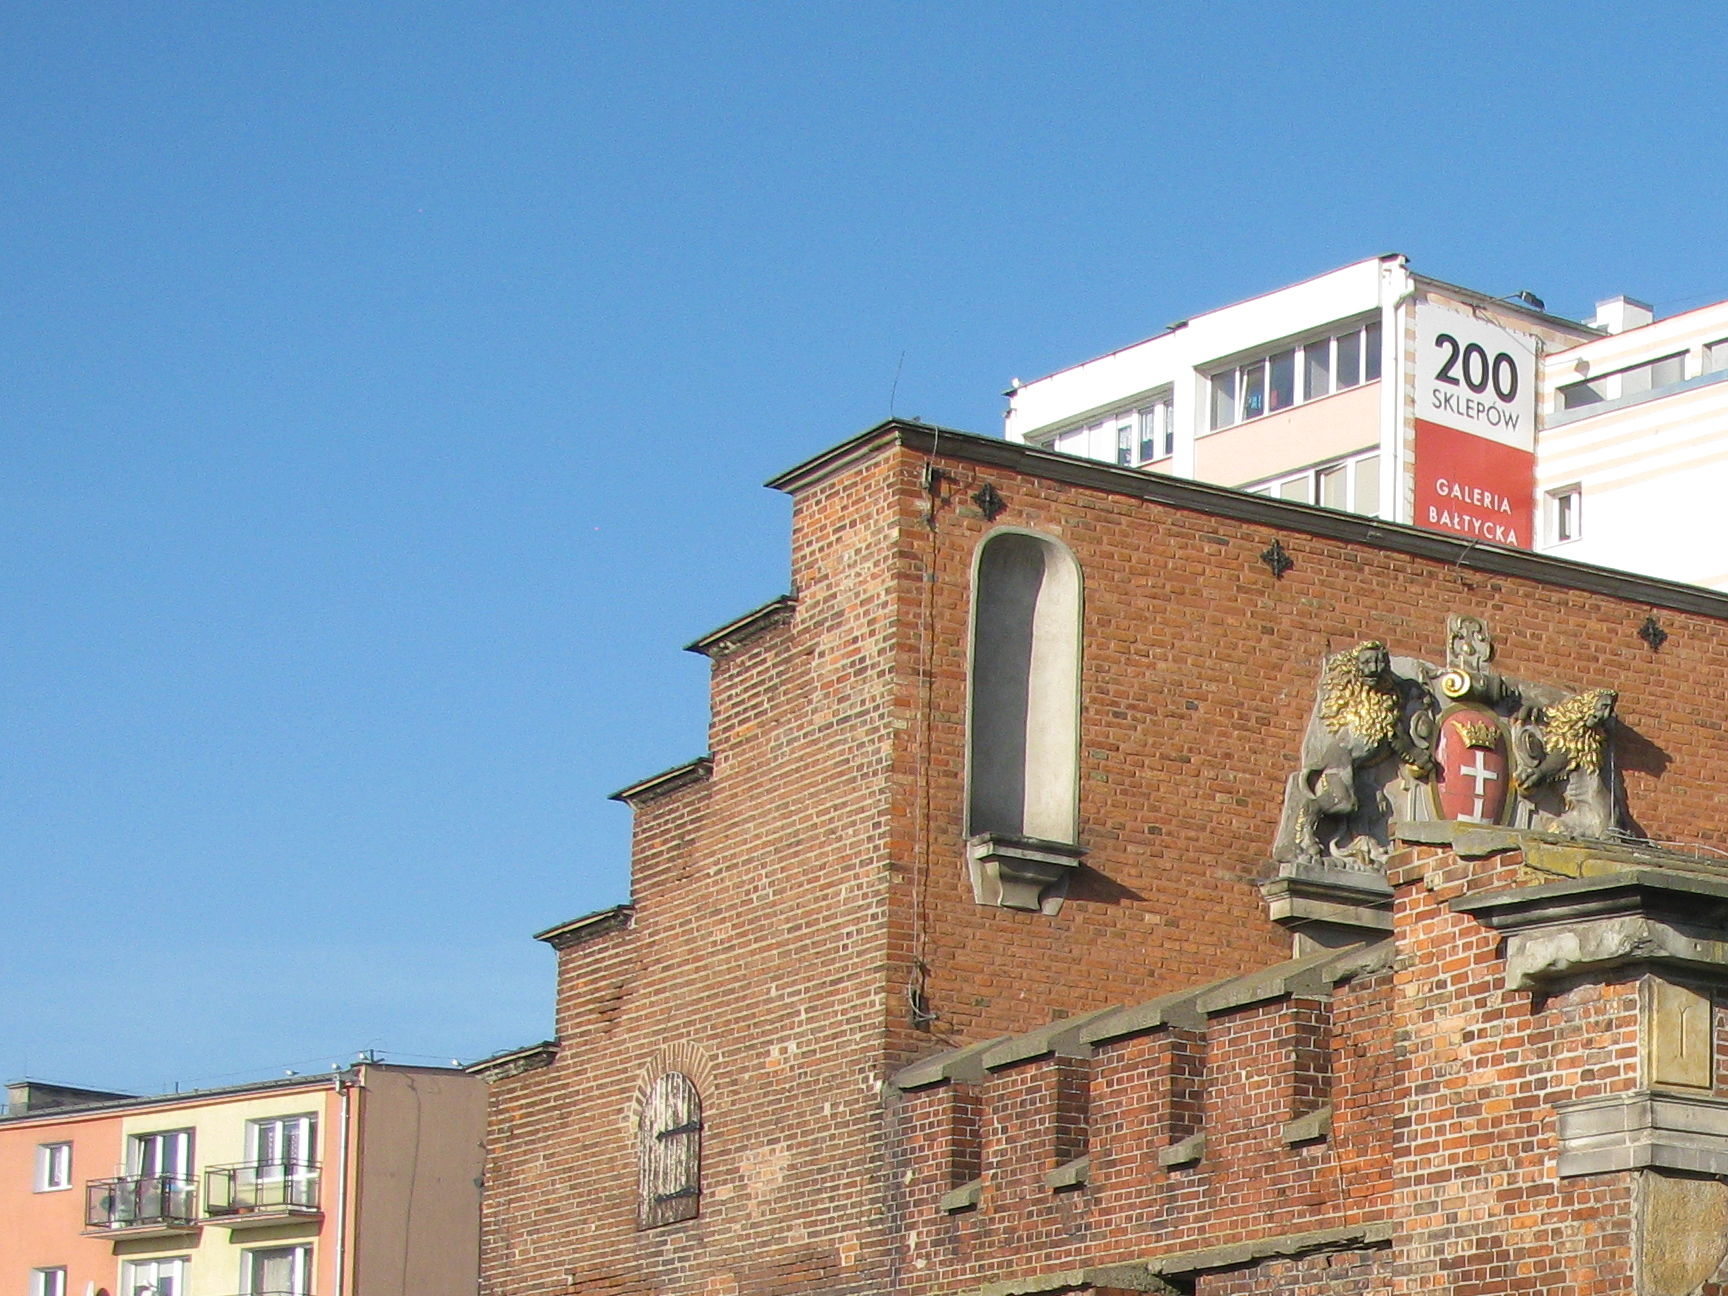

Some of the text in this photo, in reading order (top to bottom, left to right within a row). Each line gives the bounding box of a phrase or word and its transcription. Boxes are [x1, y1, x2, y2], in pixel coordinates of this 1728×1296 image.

[1434, 333, 1518, 403] 200
[1432, 388, 1520, 432] SKLEPÓW
[1435, 478, 1512, 514] GALERIA
[1428, 506, 1518, 546] BAŁTYCKA
